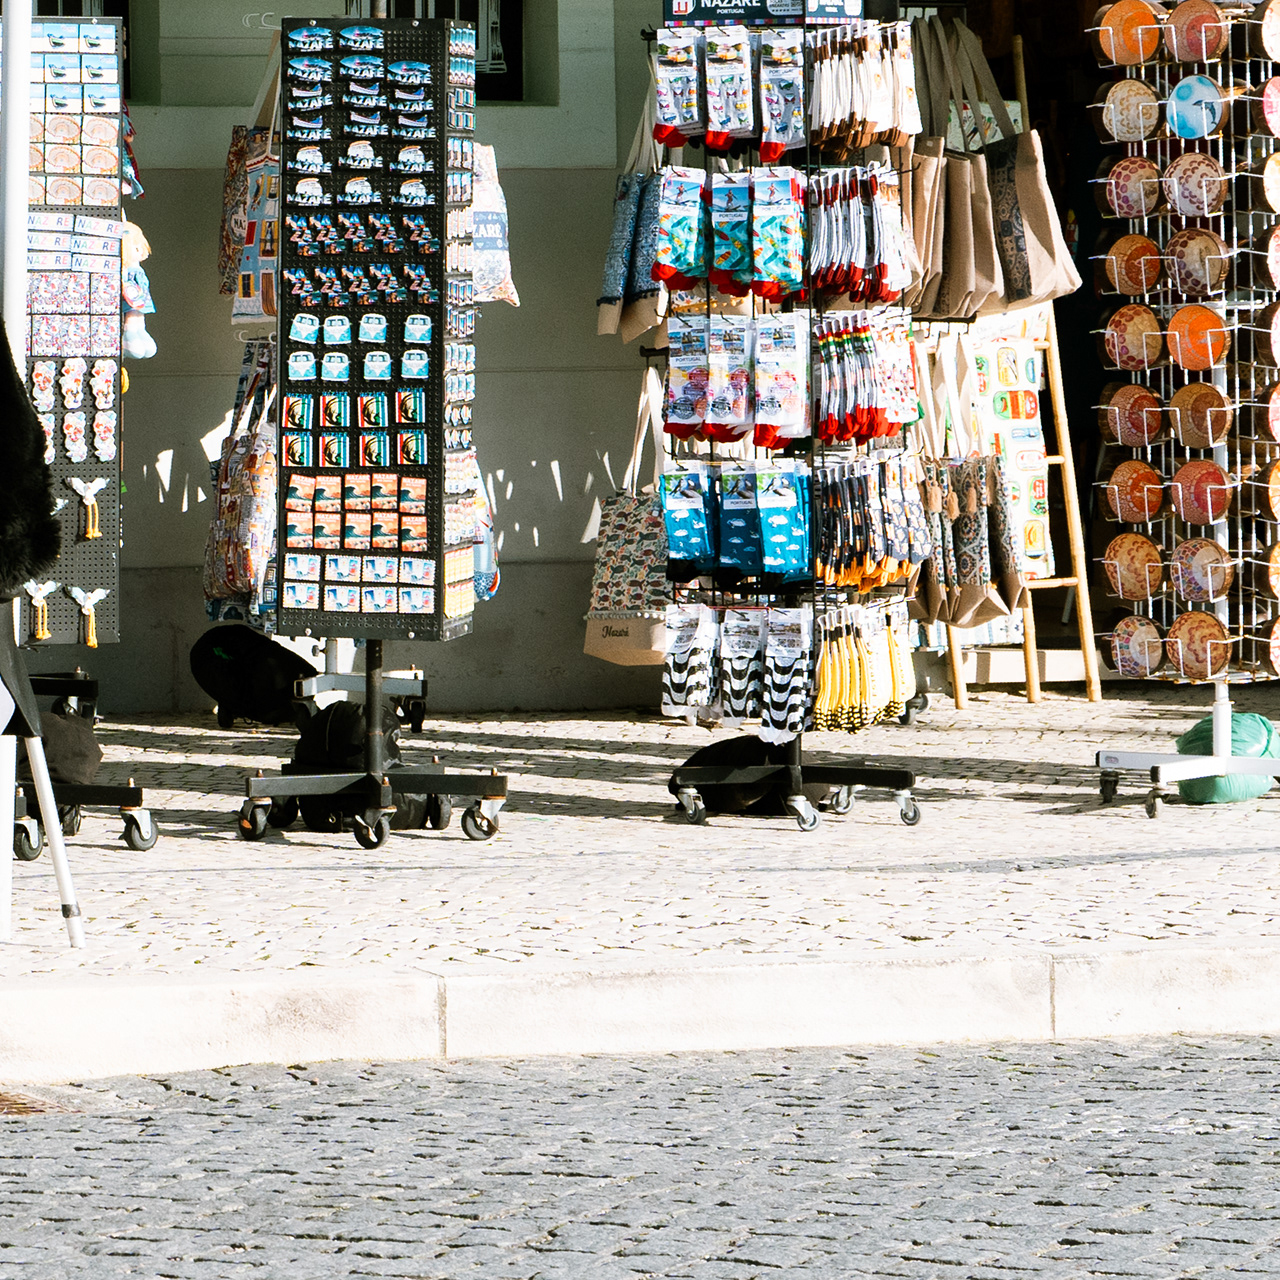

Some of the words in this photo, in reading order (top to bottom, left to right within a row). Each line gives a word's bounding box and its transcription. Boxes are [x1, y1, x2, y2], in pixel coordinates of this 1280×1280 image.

[288, 38, 334, 50] NAZARÉ
[339, 37, 385, 49] NAZARÉ
[287, 67, 333, 82] NAZARÉ
[339, 66, 385, 78] NAZARÉ
[387, 72, 432, 85] NAZARÉ
[288, 94, 334, 110] NAZARÉ
[342, 94, 388, 107] NAZARÉ
[389, 100, 434, 111] NAZARÉ
[286, 128, 332, 140] NAZARÉ
[343, 124, 389, 136] NAZARÉ
[391, 127, 437, 139] NAZARÉ
[286, 160, 332, 173] NAZARÉ
[338, 156, 384, 168] NAZARÉ
[389, 160, 435, 173] NAZARÉ
[286, 192, 332, 205] NAZARÉ
[336, 192, 382, 204] NAZARÉ
[391, 195, 436, 206] NAZARÉ
[601, 624, 630, 639] Nazaré
